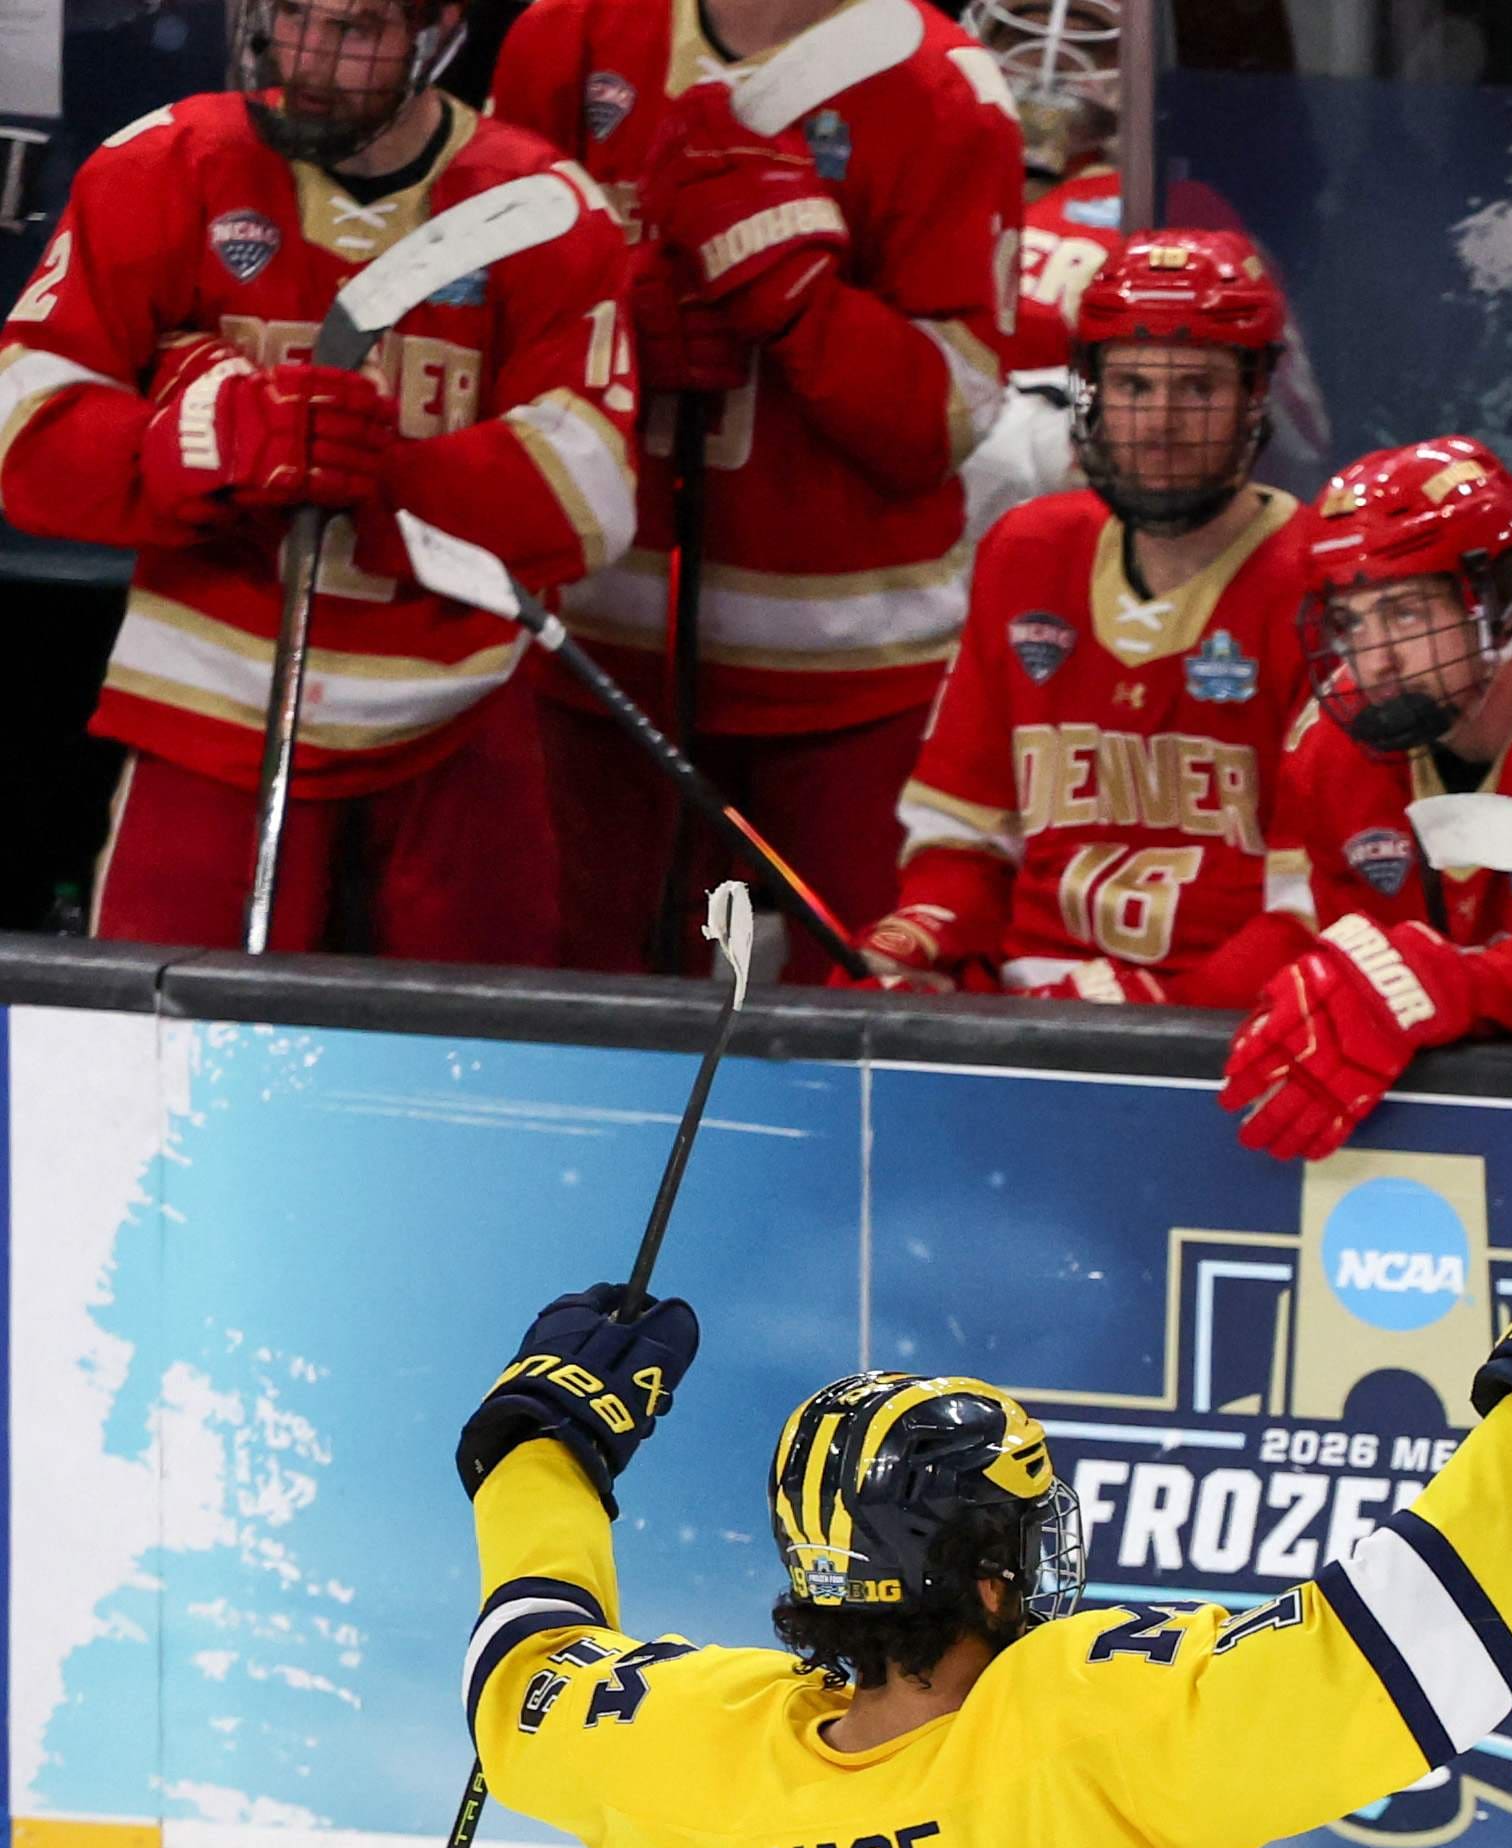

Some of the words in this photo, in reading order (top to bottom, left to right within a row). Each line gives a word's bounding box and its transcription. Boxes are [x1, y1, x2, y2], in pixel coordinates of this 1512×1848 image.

[1012, 722, 1266, 855] DENVER
[1058, 842, 1205, 965] 16
[1337, 1248, 1466, 1297] NCAA
[1259, 1428, 1379, 1465] 2026
[1066, 1459, 1412, 1580] FROZE
